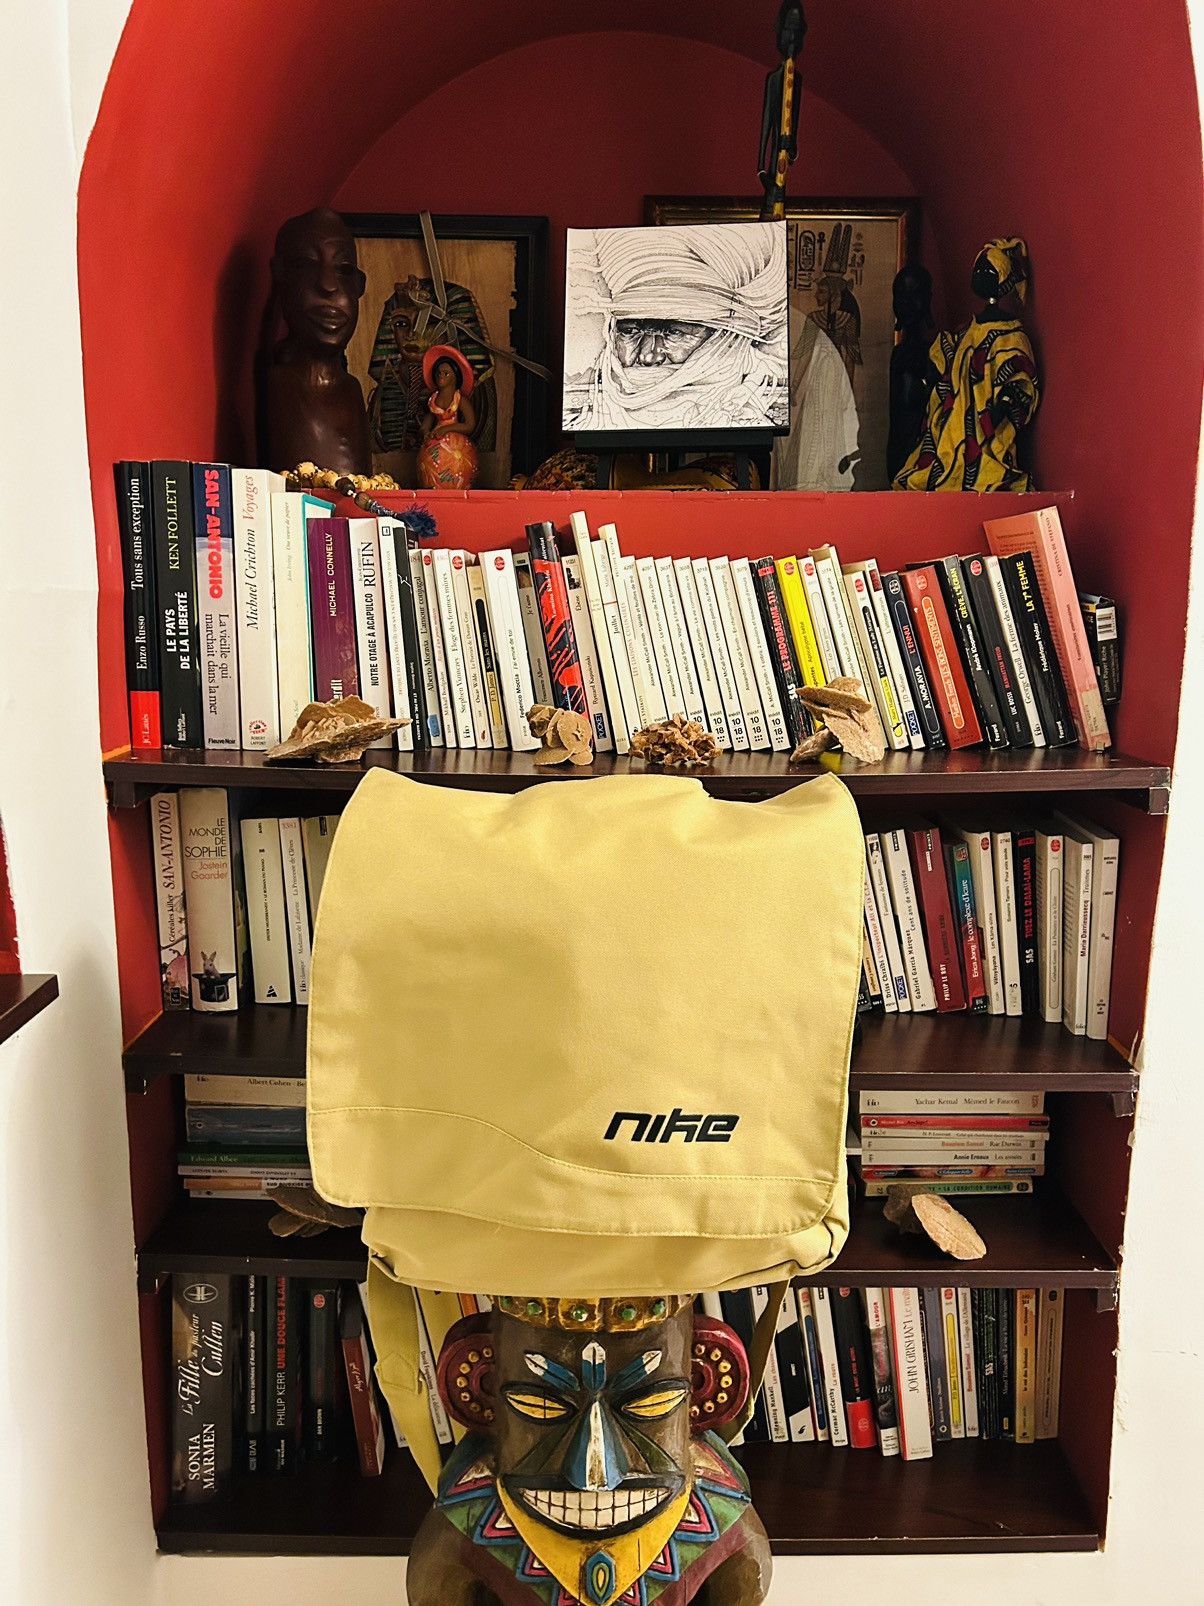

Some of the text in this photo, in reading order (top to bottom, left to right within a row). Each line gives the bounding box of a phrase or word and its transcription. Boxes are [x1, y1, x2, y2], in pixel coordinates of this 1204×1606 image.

[127, 478, 144, 589] Tous sans exception
[165, 476, 179, 569] KEN FOLLETT
[204, 470, 222, 598] SAN-ANTONIO
[242, 476, 258, 629] Michael Crichton Voyages
[360, 540, 376, 587] RUFIN
[325, 532, 336, 616] MICHAEL CONNELLY
[1015, 560, 1030, 590] FEMME
[364, 593, 374, 629] ACAPULCO
[444, 594, 453, 619] femmes
[1025, 600, 1035, 611] LA
[164, 608, 176, 651] LE PAYS
[175, 591, 190, 669] DE LA LIBERTÉ
[414, 575, 433, 691] Alberto Moravia L'amour conjugal
[610, 614, 620, 634] Juillet
[1032, 621, 1042, 640] Molay
[135, 615, 147, 669] Enzo Russo
[218, 613, 230, 678] La vieille qui
[367, 639, 376, 661] OTAGE
[770, 606, 791, 670] LE PROGRAMME
[902, 625, 915, 654] L'ENNUI
[965, 623, 978, 652] Klopmann
[995, 580, 1032, 704] George Orwell La ferme des animaux
[205, 613, 218, 714] marchait dans la mer
[682, 655, 690, 671] McCall
[702, 658, 710, 681] Alexander
[737, 651, 745, 667] McCall
[972, 653, 982, 671] André
[369, 663, 378, 685] NOTRE
[646, 663, 655, 686] Alexander
[686, 672, 694, 694] Alexander
[741, 668, 750, 690] Alexander
[457, 687, 467, 713] Stephen
[787, 682, 798, 699] SAS
[1006, 691, 1017, 715] LUC BOSSI
[517, 694, 525, 718] Federico
[595, 713, 605, 738] POCKET
[907, 710, 919, 735] POCKET
[991, 723, 1000, 741] Fayard
[1056, 720, 1065, 738] Fayard
[189, 828, 225, 836] MONDE
[217, 818, 225, 826] LE
[158, 799, 174, 889] SAN-ANTONIO
[185, 846, 226, 857] SOPHIE
[215, 837, 225, 845] DE
[900, 869, 909, 894] solitude
[960, 879, 970, 902] d'Icare
[166, 894, 175, 942] Céréales killer
[963, 903, 974, 935] complexe
[968, 945, 977, 960] Jong
[1025, 949, 1033, 962] SAS
[970, 961, 980, 977] Erica
[883, 983, 891, 998] Driss
[896, 976, 906, 999] POCKET
[912, 977, 922, 999] Gabriel
[604, 1108, 739, 1142] nike
[190, 1313, 201, 1346] pasteur
[200, 1321, 222, 1376] Cullen
[903, 1320, 919, 1393] JOHN GRISHAM
[276, 1309, 285, 1425] PHILIP KERR UNE DOUCE
[985, 1362, 993, 1375] SAS
[176, 1359, 200, 1415] La Fille
[828, 1388, 839, 1435] Cormac McCarthy
[188, 1434, 200, 1479] SONIA
[203, 1423, 214, 1488] MARMEN
